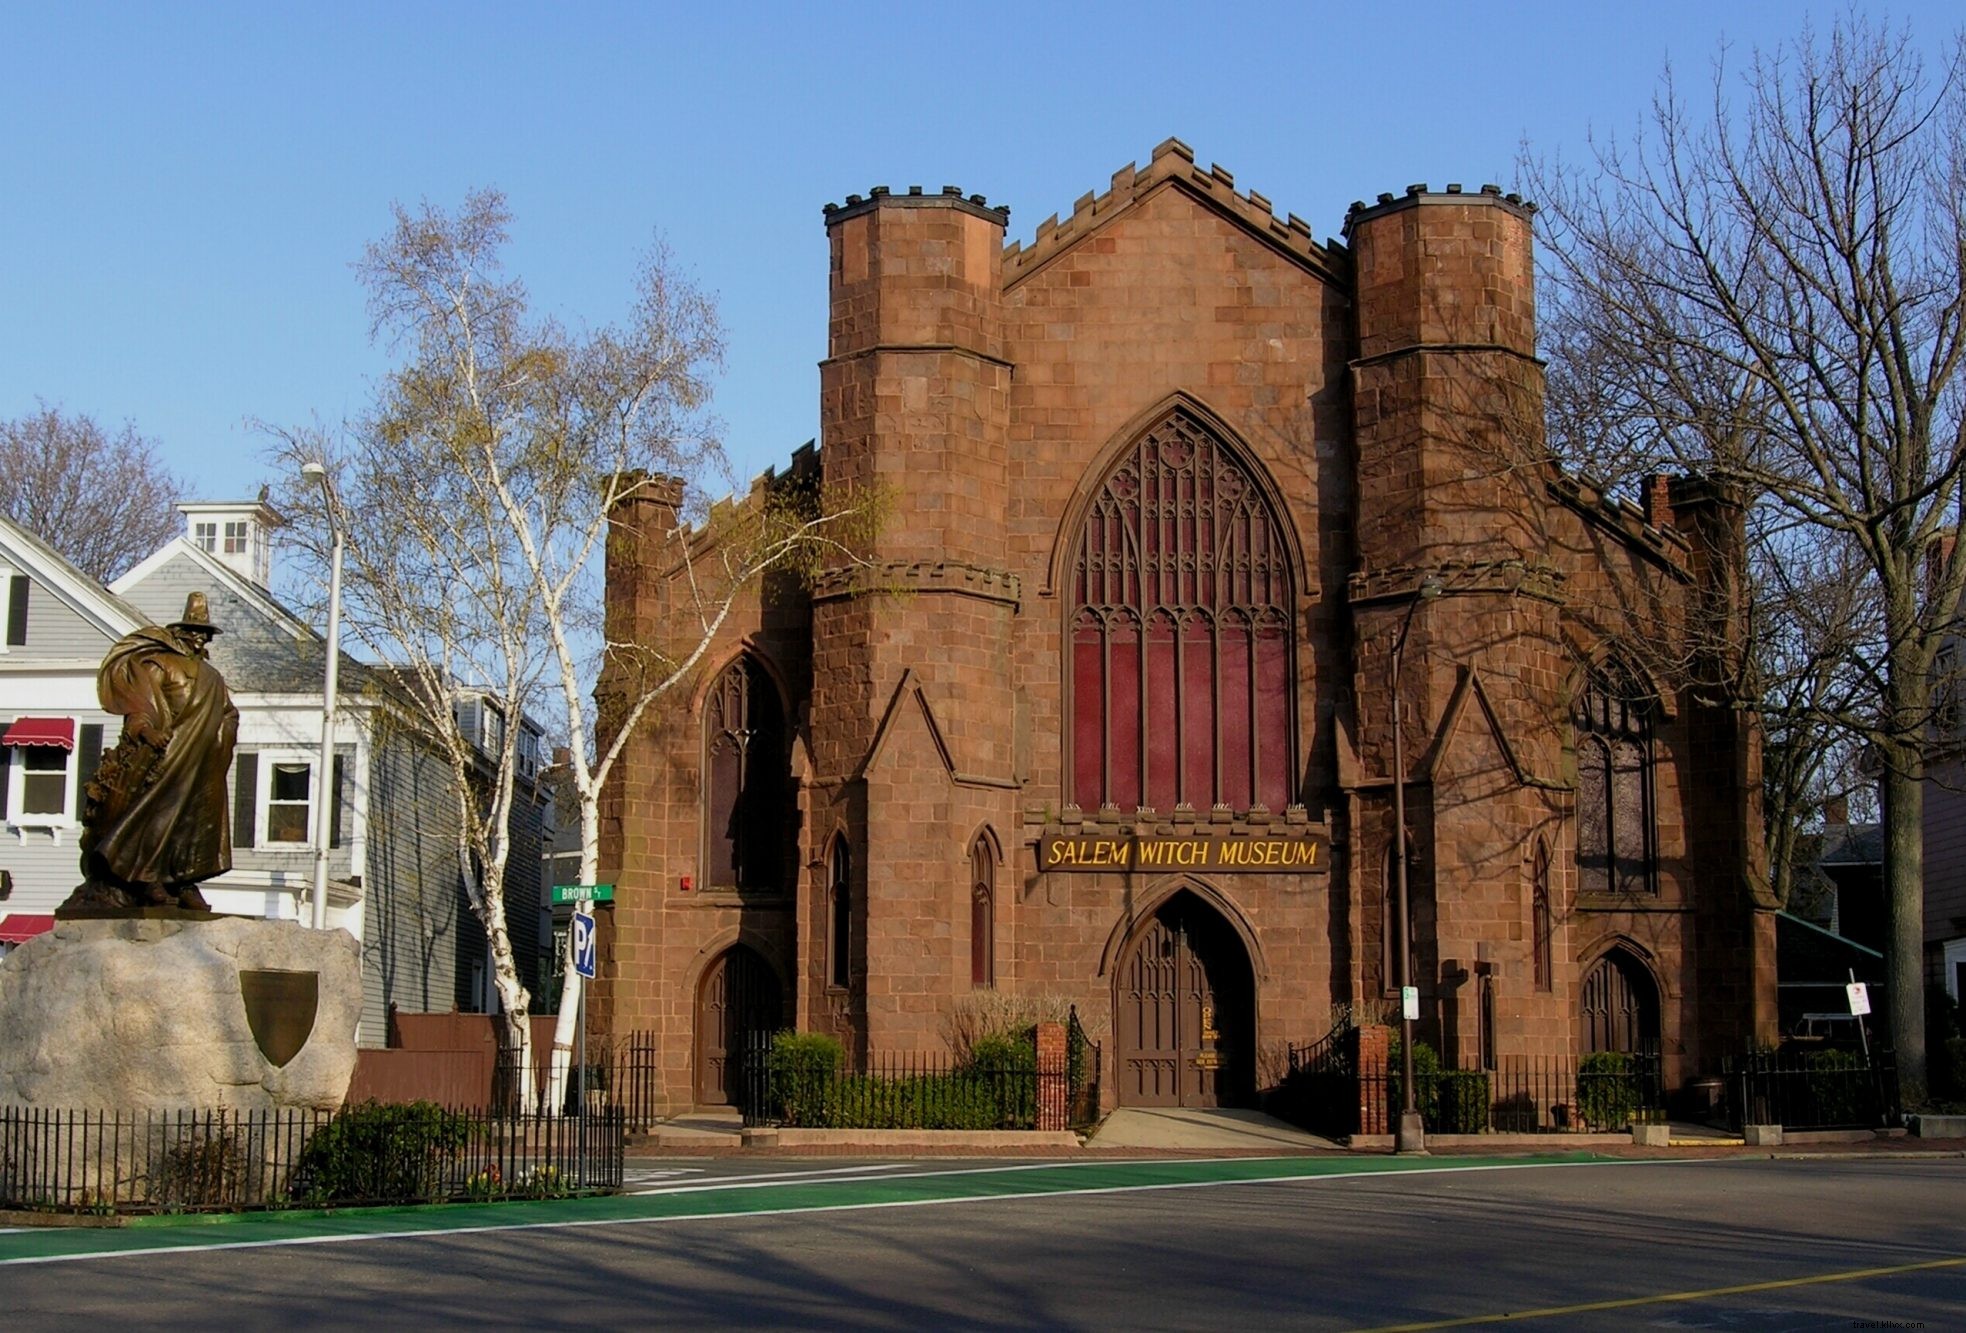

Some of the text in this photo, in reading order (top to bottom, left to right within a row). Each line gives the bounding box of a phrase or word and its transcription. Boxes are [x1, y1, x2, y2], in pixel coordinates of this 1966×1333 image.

[1048, 841, 1318, 865] SALEM WITCH MUSEUM
[561, 887, 592, 900] BROWN
